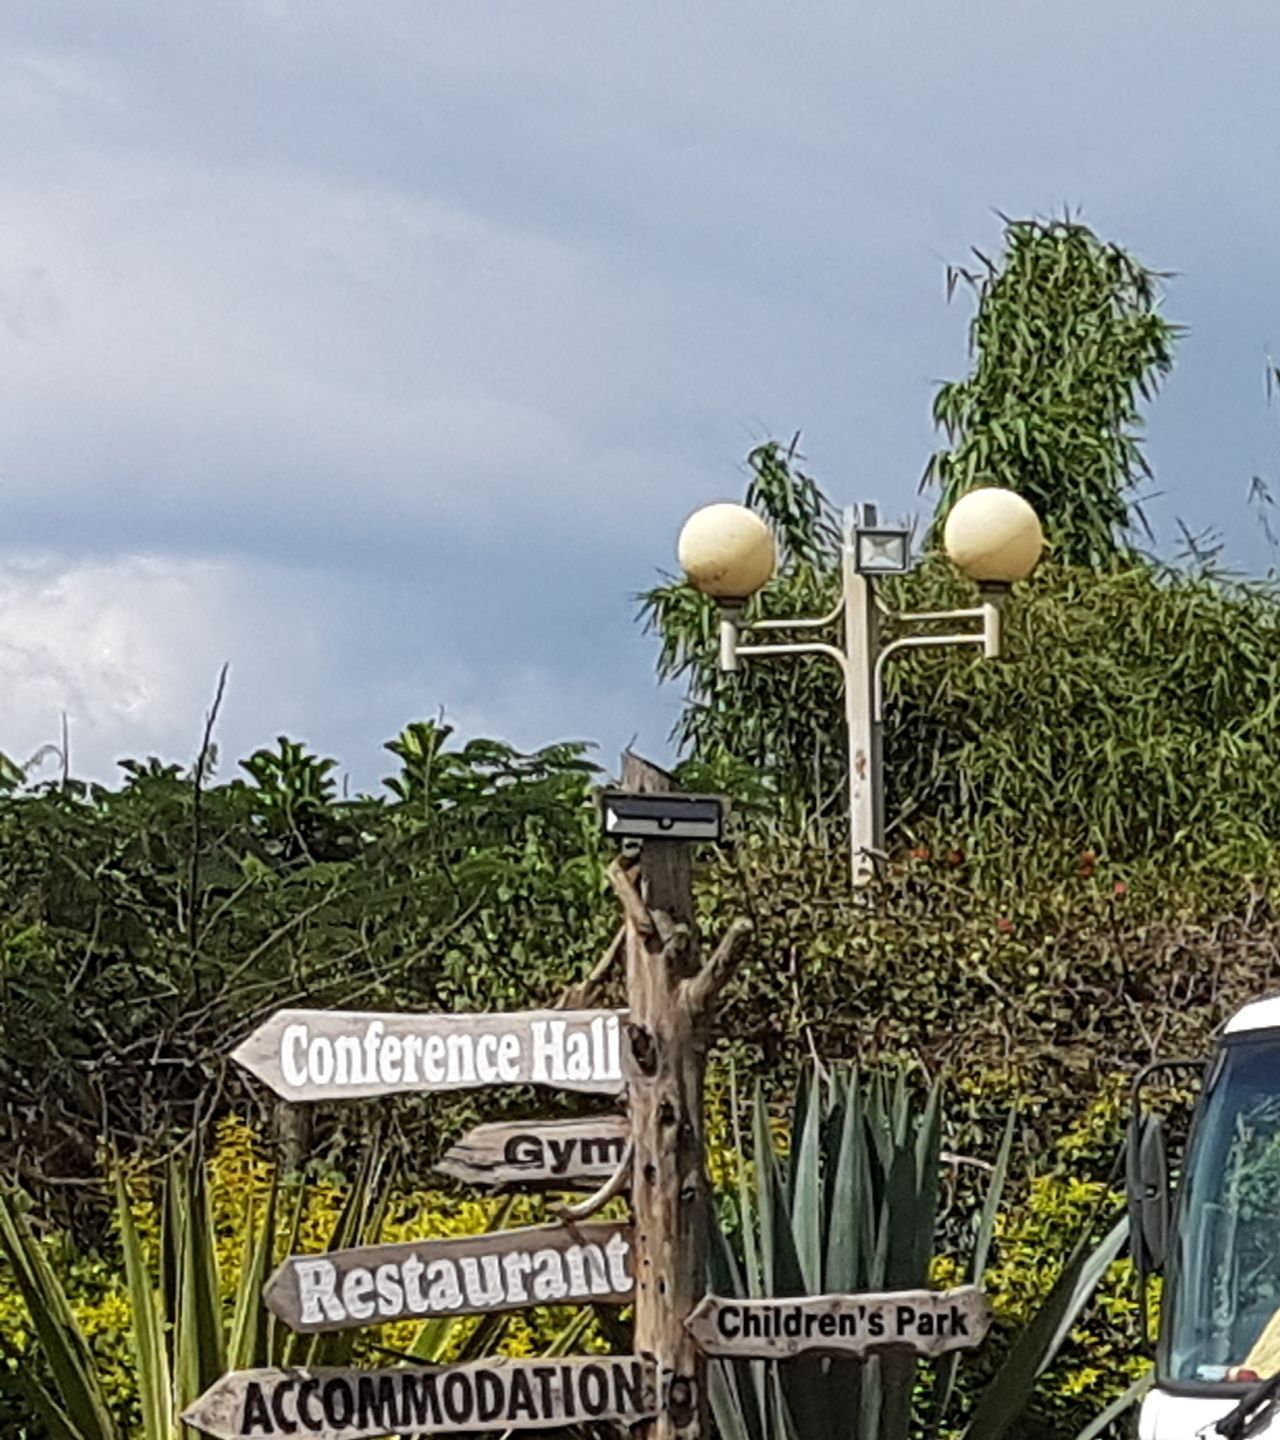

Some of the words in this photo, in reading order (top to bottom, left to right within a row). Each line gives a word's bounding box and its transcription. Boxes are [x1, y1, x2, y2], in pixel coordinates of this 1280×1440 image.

[281, 1019, 519, 1087] Conference
[531, 1015, 622, 1083] Hall
[504, 1133, 627, 1176] Gym
[294, 1231, 635, 1326] Restaurant
[717, 1304, 883, 1340] Children's
[896, 1304, 969, 1338] Park
[240, 1360, 645, 1436] ACCOMMODATION
